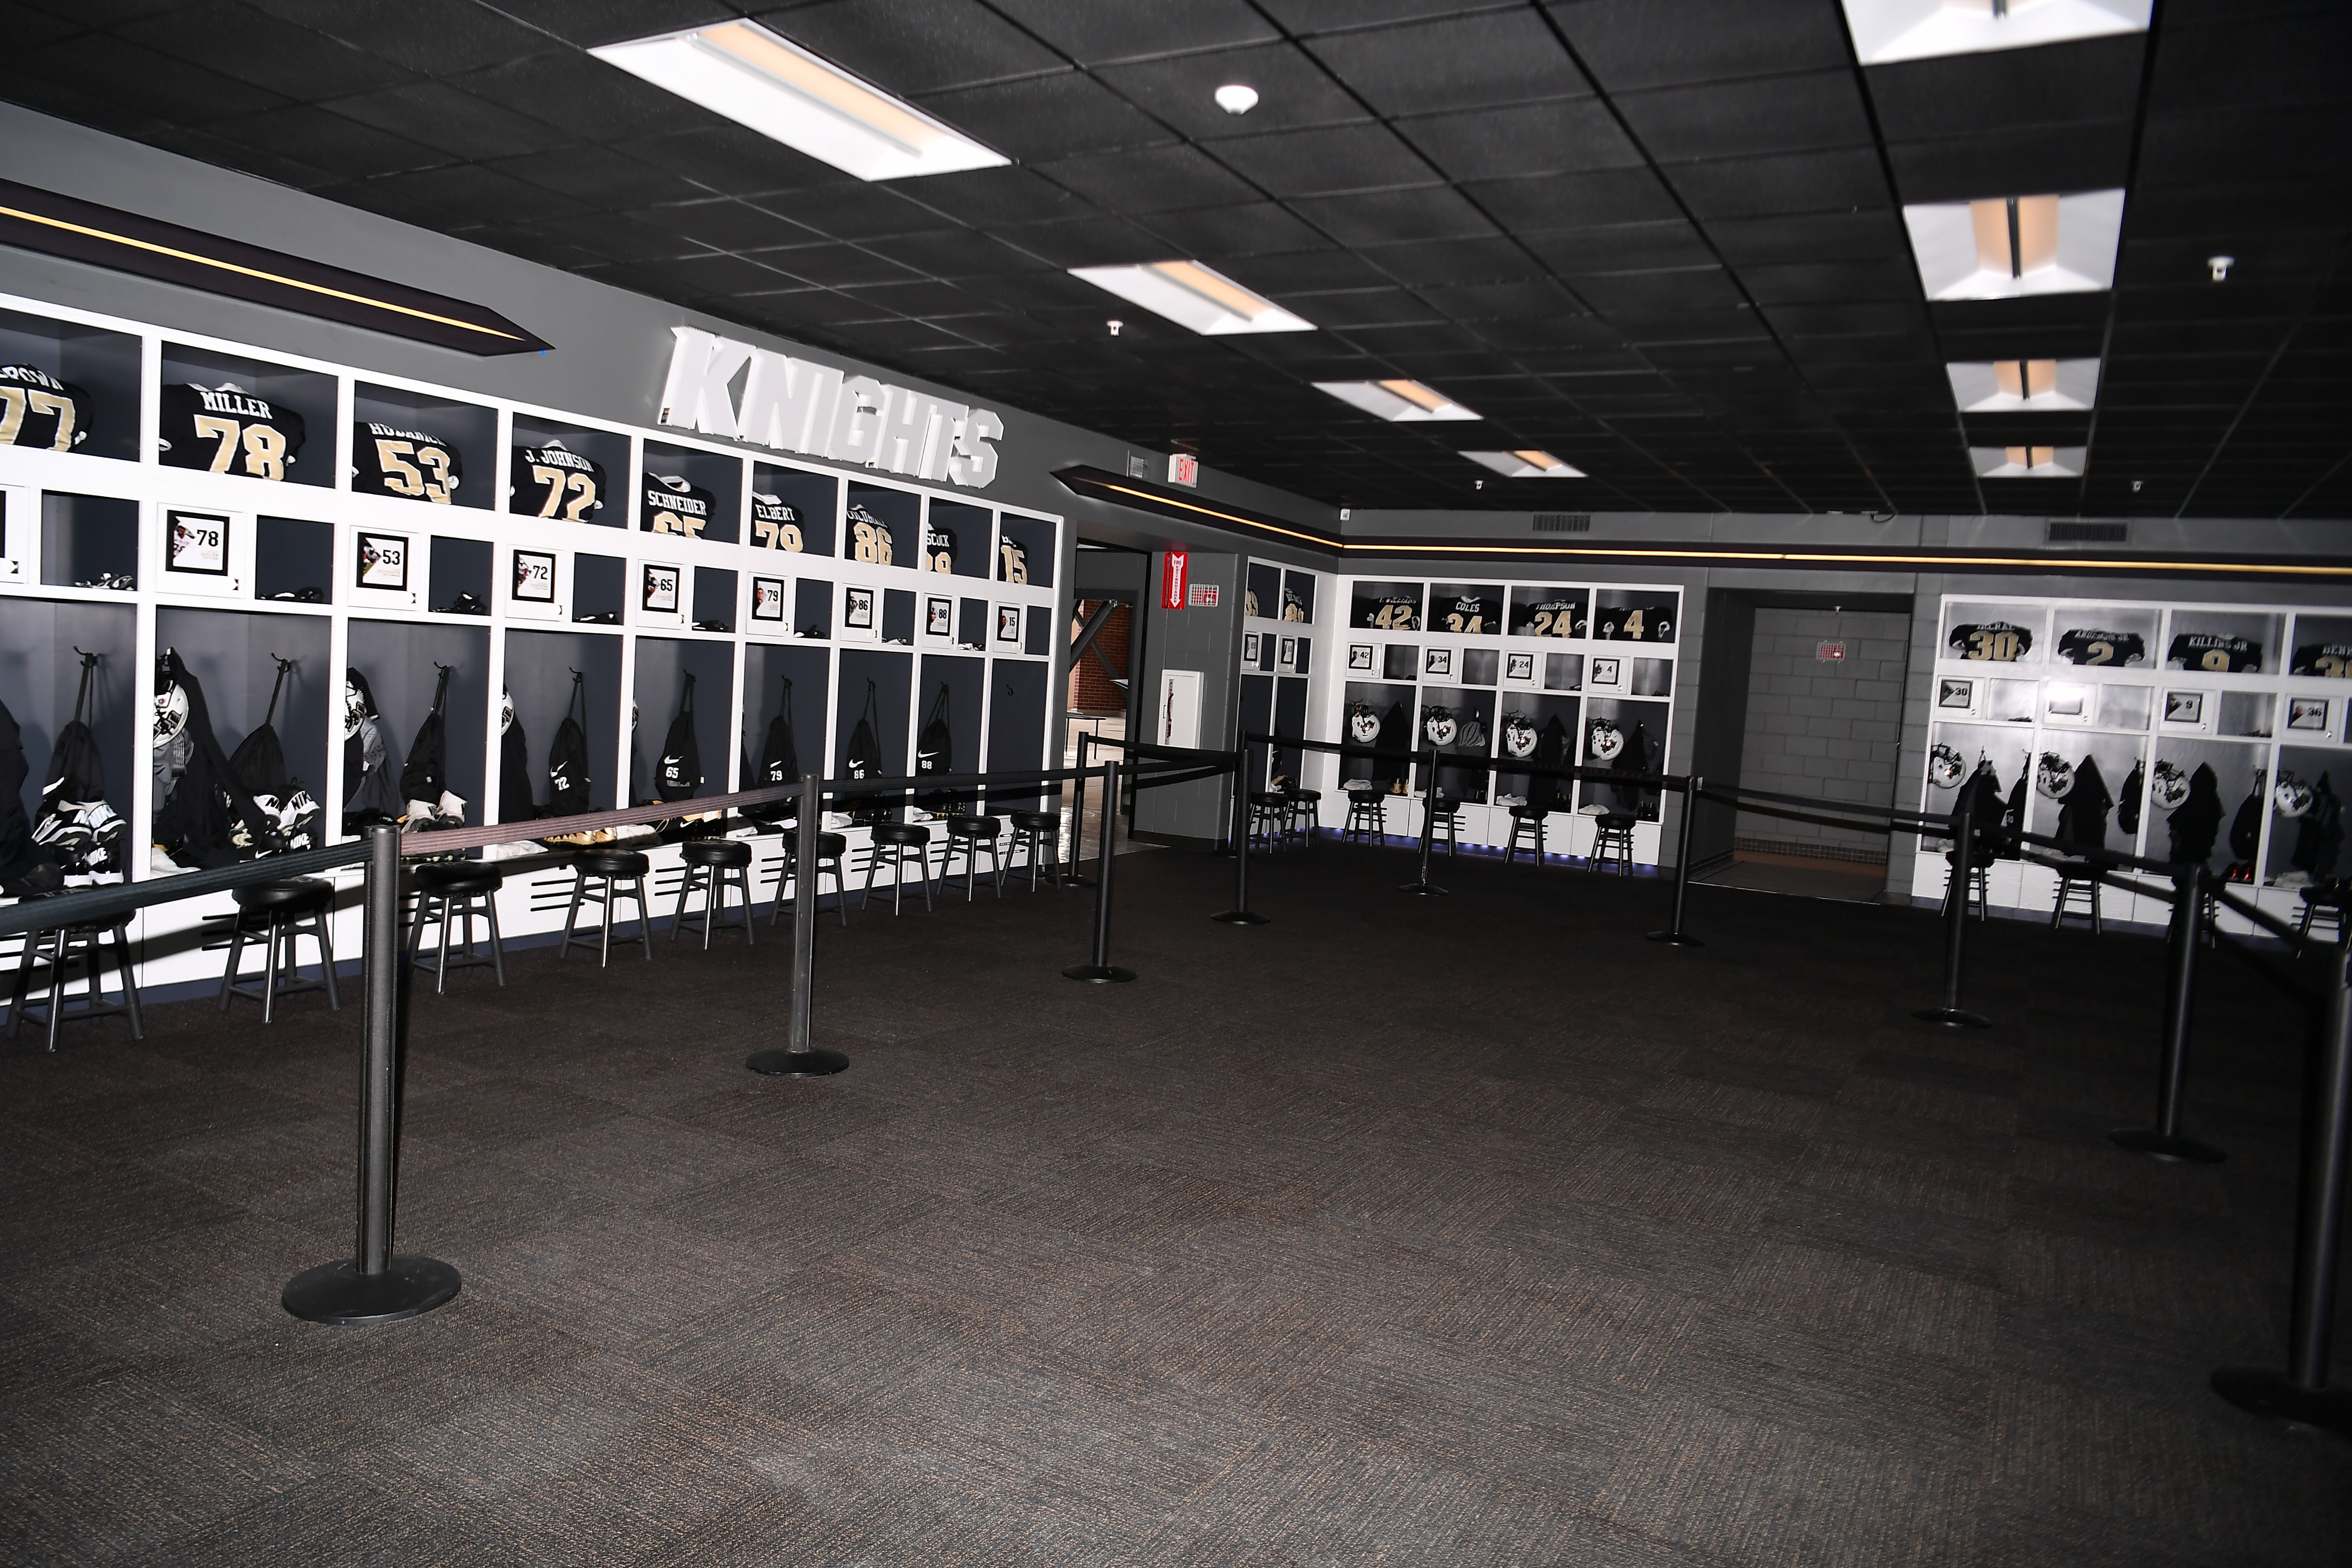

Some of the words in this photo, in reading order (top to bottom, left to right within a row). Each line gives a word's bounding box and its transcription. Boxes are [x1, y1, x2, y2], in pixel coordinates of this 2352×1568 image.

[199, 391, 273, 420] MILLER
[658, 326, 1004, 489] KNIGHTS
[193, 414, 286, 481] 78
[525, 449, 541, 463] J.
[540, 449, 595, 473] JOHNSON
[375, 439, 452, 505] 53
[1179, 458, 1195, 484] EXIT
[532, 465, 596, 523] 72
[648, 490, 707, 516] SCHNEIDER
[755, 504, 795, 521] ELBERT
[197, 529, 219, 547] 78
[853, 522, 893, 565] 86
[382, 549, 400, 565] 53
[1001, 545, 1027, 584] 15
[533, 565, 548, 580] 72
[660, 578, 673, 592] 65
[767, 589, 779, 602] 79
[858, 599, 869, 611] 86
[938, 608, 947, 620] 88
[1455, 602, 1480, 613] COLES
[1535, 602, 1575, 611] THOMPSON
[1009, 616, 1015, 627] 15
[1375, 604, 1413, 630] 42
[1447, 613, 1483, 634] 34
[1534, 611, 1572, 638] 24
[1623, 609, 1645, 640] 4
[1968, 630, 2019, 661] 30
[2087, 641, 2114, 666] 2
[1955, 687, 1968, 696] 30
[666, 767, 679, 779] 65
[854, 769, 865, 779] 86
[921, 760, 932, 770] 88
[554, 776, 570, 791] 72
[770, 770, 783, 781] 79
[290, 832, 310, 849] NIKE
[87, 847, 108, 867] NIKE
